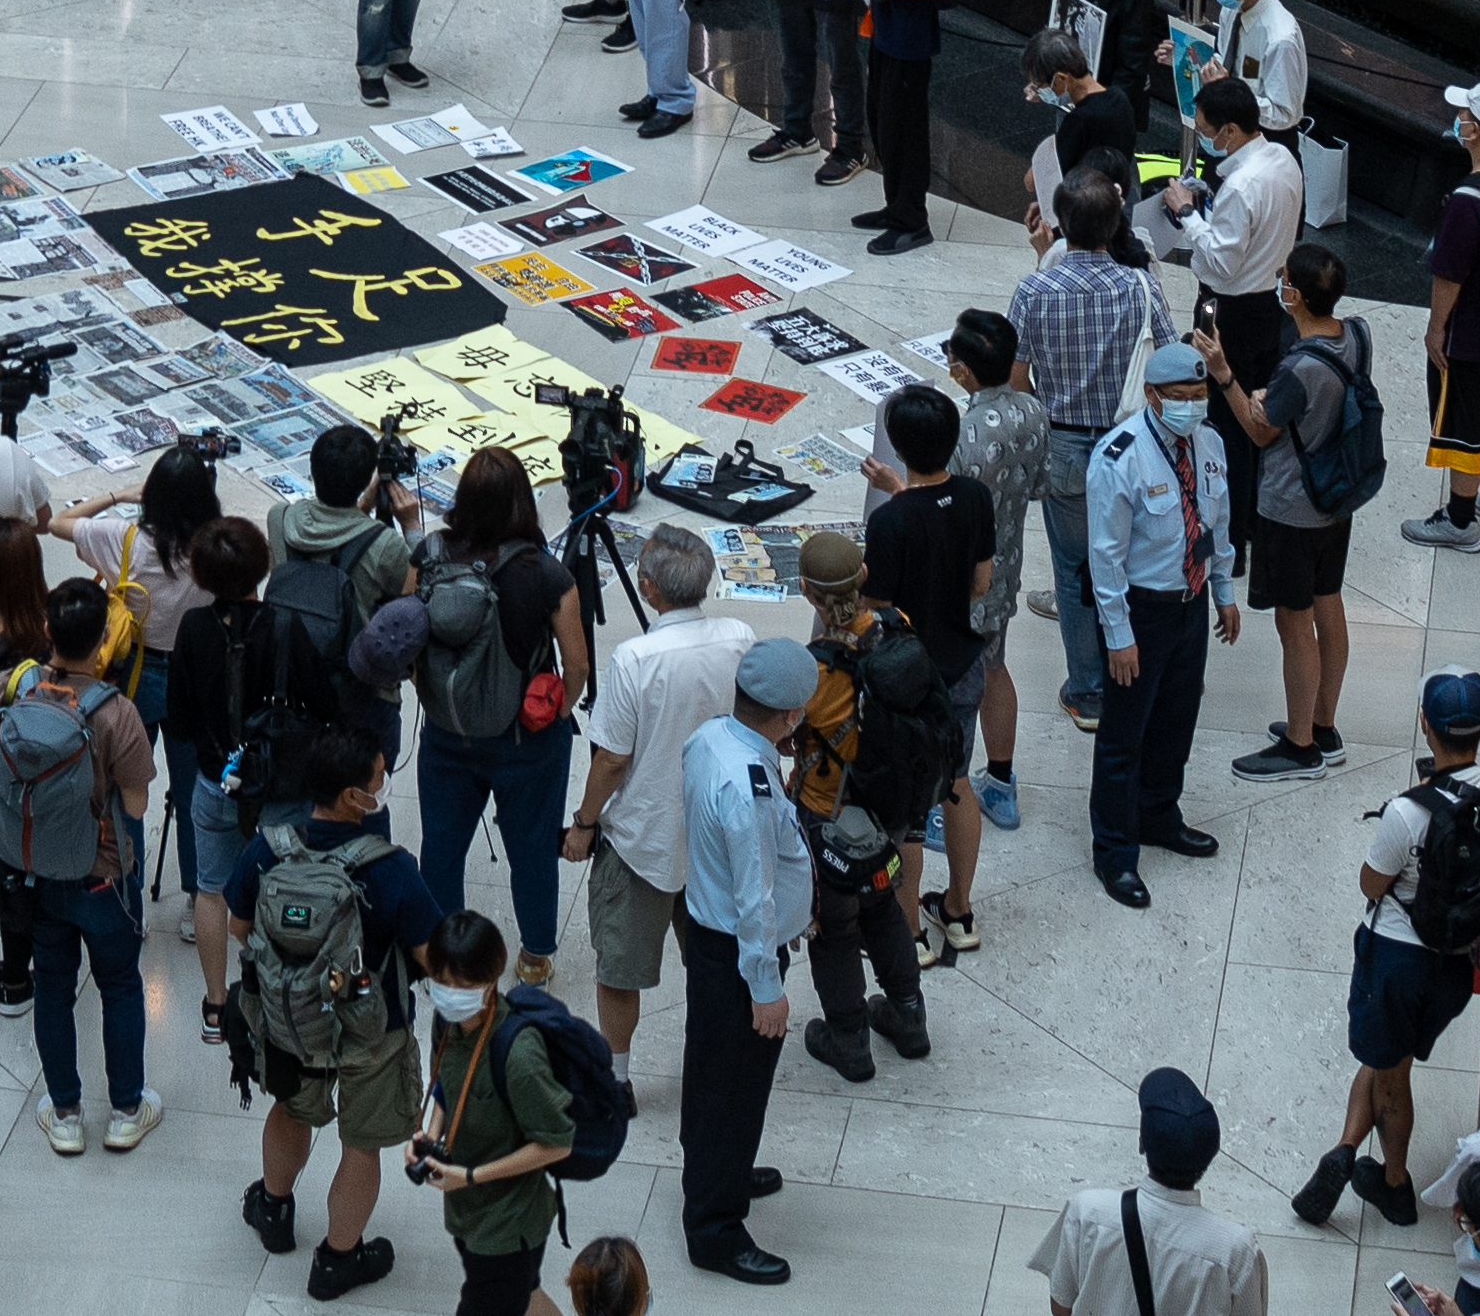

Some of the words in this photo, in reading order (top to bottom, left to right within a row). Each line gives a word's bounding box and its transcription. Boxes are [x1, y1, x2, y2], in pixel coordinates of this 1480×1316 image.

[169, 119, 194, 137] FREE
[661, 225, 711, 250] MATTER
[688, 223, 722, 240] LIVES
[702, 216, 743, 236] BLACK
[256, 209, 462, 321] 手足
[747, 258, 798, 284] MATTER
[774, 256, 809, 274] LIVES
[787, 247, 832, 271] YOUNG
[123, 218, 345, 349] 我撐你
[822, 849, 850, 874] PRESS
